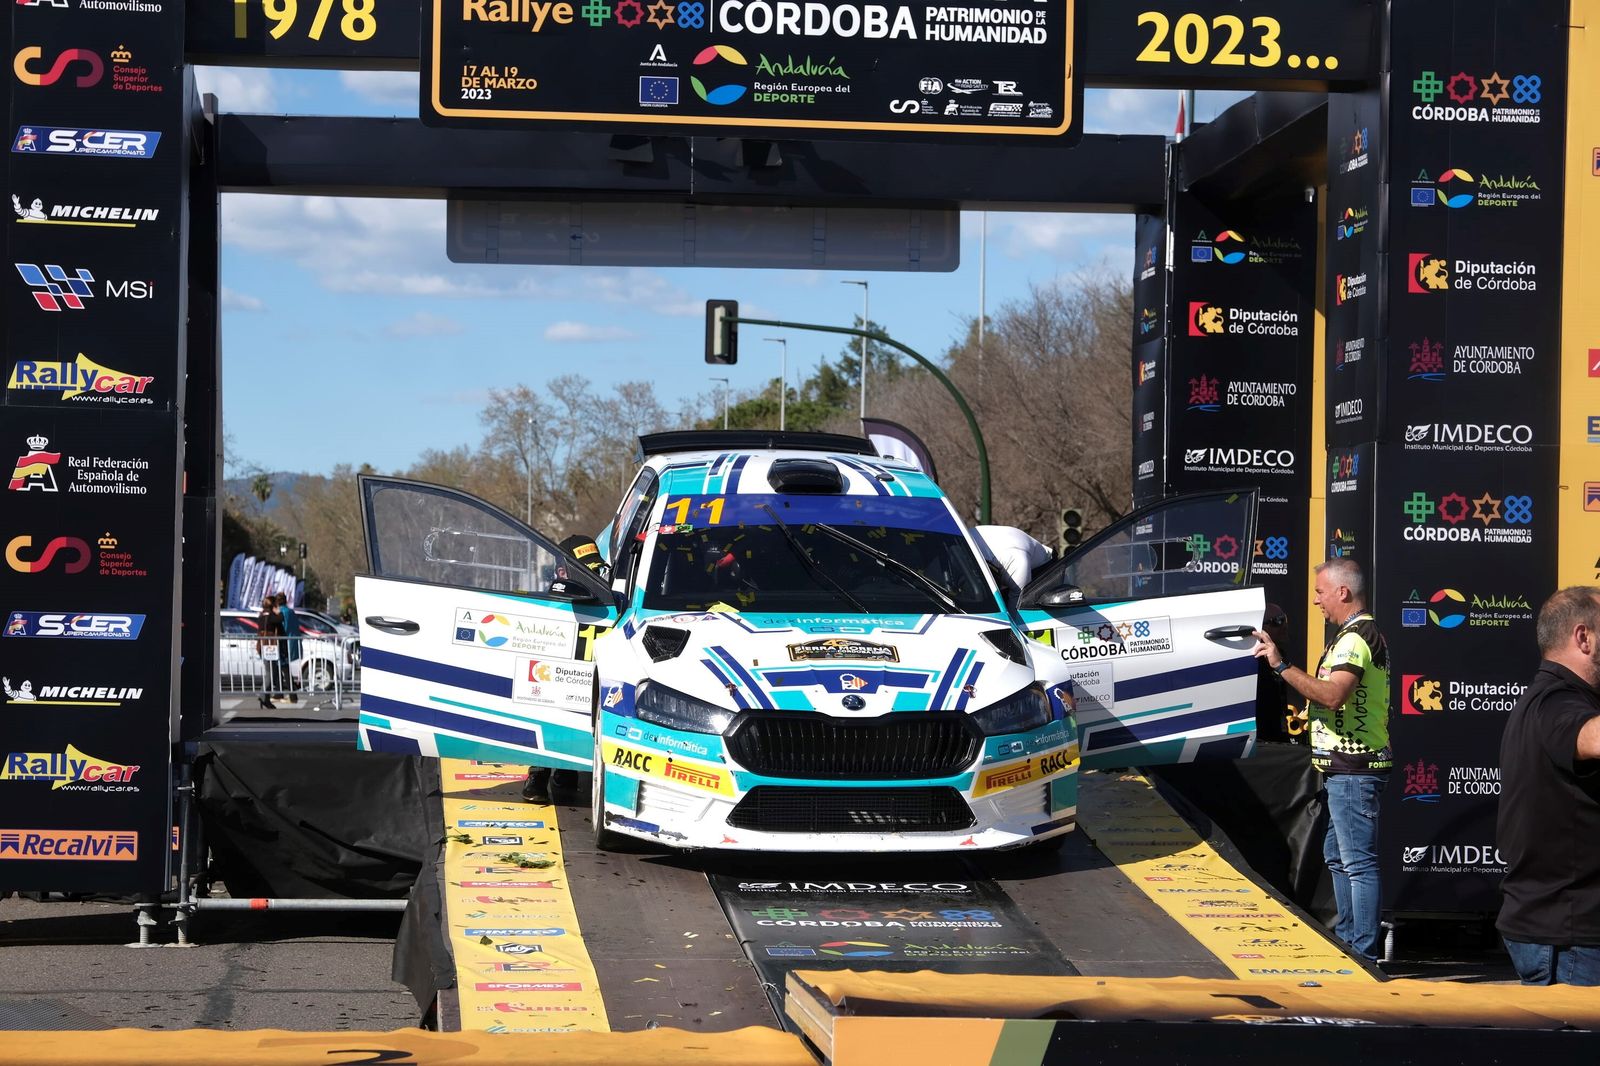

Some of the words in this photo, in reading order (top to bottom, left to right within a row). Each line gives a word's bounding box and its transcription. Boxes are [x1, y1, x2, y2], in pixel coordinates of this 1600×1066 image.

[79, 0, 162, 13] Automovilismo
[463, 0, 574, 32] Rallye
[926, 7, 1033, 24] PATRIMONIO
[925, 24, 1048, 44] HUMANIDAD
[113, 65, 147, 75] Consejo
[462, 65, 476, 77] 17
[480, 66, 499, 77] AL
[504, 66, 518, 78] 19
[755, 53, 850, 79] Andalucía
[113, 74, 149, 84] Superior
[461, 77, 480, 88] DE
[485, 77, 538, 90] MARZO
[112, 82, 124, 91] de
[125, 83, 163, 93] Deportes
[461, 88, 492, 100] 2023
[754, 81, 787, 92] Región
[791, 83, 832, 93] Europea
[836, 84, 851, 93] del
[753, 92, 815, 104] DEPORTE
[1412, 103, 1489, 121] CÓRDOBA
[1492, 108, 1535, 116] PATRIMONIO
[1492, 115, 1541, 123] HUMANIDAD
[46, 130, 147, 152] S-CER
[1479, 174, 1541, 190] Andalucía
[1478, 192, 1501, 200] Región
[51, 205, 159, 221] MICHELIN
[1454, 260, 1536, 276] Diputación
[1454, 278, 1472, 290] de
[1476, 276, 1536, 291] Córdoba
[1229, 308, 1298, 323] Diputación
[1229, 322, 1244, 334] de
[1247, 322, 1298, 336] Córdoba
[1453, 345, 1535, 360] AYUNTAMIENTO
[1453, 360, 1467, 373] DE
[1469, 357, 1522, 374] CÓRDOBA
[1227, 381, 1297, 395] AYUNTAMIENTO
[71, 395, 154, 405] www.rallycar.es
[1227, 394, 1238, 405] DE
[1240, 392, 1285, 407] CÓRDOBA
[1340, 398, 1363, 417] IMDECO
[1433, 424, 1533, 444] IMDECO
[1404, 443, 1431, 451] Instituto
[1432, 444, 1464, 452] Municipal
[1474, 445, 1504, 453] Deportes
[68, 456, 90, 468] Real
[93, 457, 149, 470] Federación
[1209, 448, 1295, 467] IMDECO
[77, 469, 124, 483] Española
[126, 470, 139, 482] de
[68, 481, 147, 495] Automovilismo
[1403, 524, 1482, 542] CÓRDOBA
[1484, 535, 1532, 543] HUMANIDAD
[99, 551, 132, 561] Consejo
[99, 559, 133, 568] Superior
[1185, 560, 1239, 573] CÓRDOB
[99, 568, 110, 576] de
[111, 568, 147, 577] Deportes
[1471, 594, 1532, 610] Andalucía
[1493, 612, 1521, 620] Europea
[36, 614, 132, 636] S-CER
[515, 620, 567, 639] Andalucía
[511, 642, 546, 652] DEPORTE
[1129, 637, 1165, 647] PATRIMONIO
[1130, 644, 1171, 654] HUMANIDAD
[839, 645, 892, 656] MORENA
[1060, 642, 1128, 661] CÓRDOBA
[555, 667, 593, 678] Diputació
[1069, 671, 1100, 680] utación
[554, 675, 565, 683] de
[566, 675, 593, 686] Córdob
[40, 686, 143, 699] MICHELIN
[1080, 694, 1111, 703] IMDECO
[1354, 684, 1369, 734] Motor
[1449, 698, 1466, 711] de
[1470, 697, 1518, 711] Córdo
[612, 748, 653, 773] RACC
[1040, 749, 1072, 775] RACC
[664, 761, 721, 789] PIRELLI
[985, 765, 1032, 790] PIRELLI
[1449, 767, 1501, 780] AYUNTAMI
[61, 785, 140, 793] www.rallycar.es
[1448, 781, 1461, 794] DE
[1464, 778, 1501, 795] CÓRDO
[22, 834, 114, 856] Recalvi
[1430, 865, 1461, 873] Municipal
[788, 882, 968, 891] IMDECO
